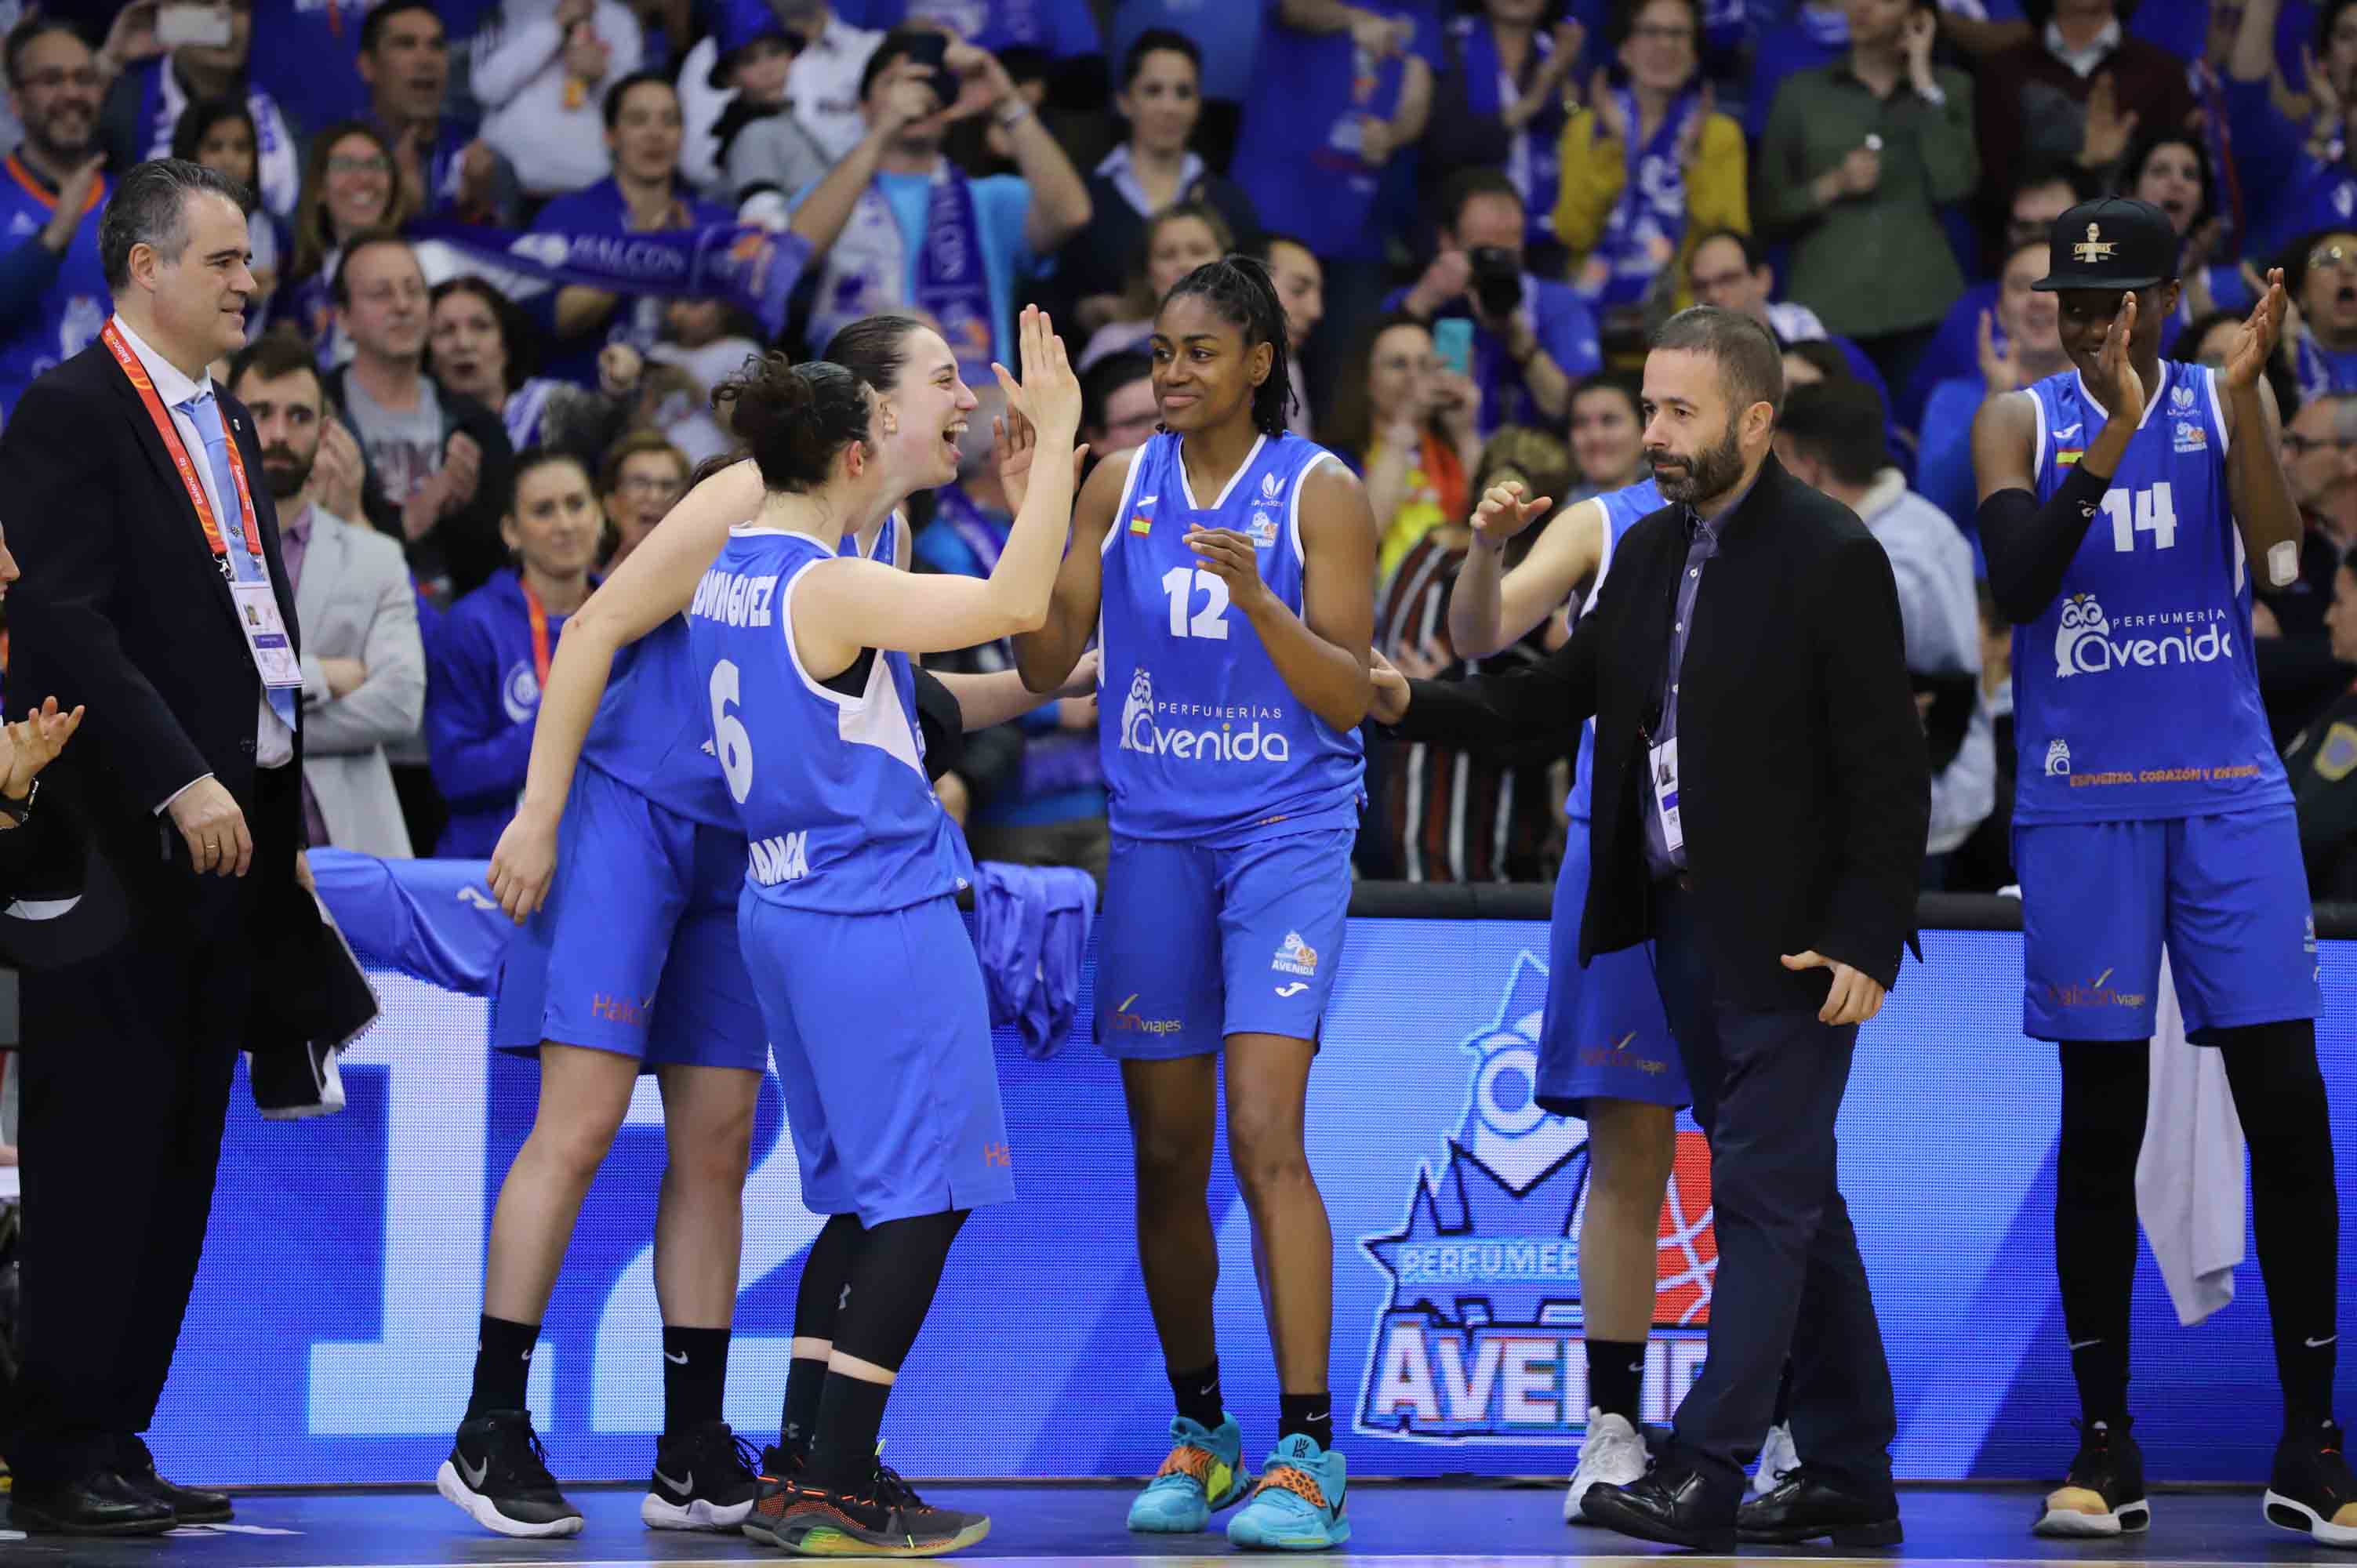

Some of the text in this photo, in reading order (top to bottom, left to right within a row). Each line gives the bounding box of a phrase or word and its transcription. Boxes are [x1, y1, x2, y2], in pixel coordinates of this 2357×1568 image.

[2101, 481, 2177, 552] 14
[1162, 566, 1229, 640] 12
[709, 659, 754, 804] 6
[1131, 712, 1289, 762] avenida
[1158, 702, 1282, 720] PERFUMERÍAS
[1271, 959, 1315, 977] AVENIDA
